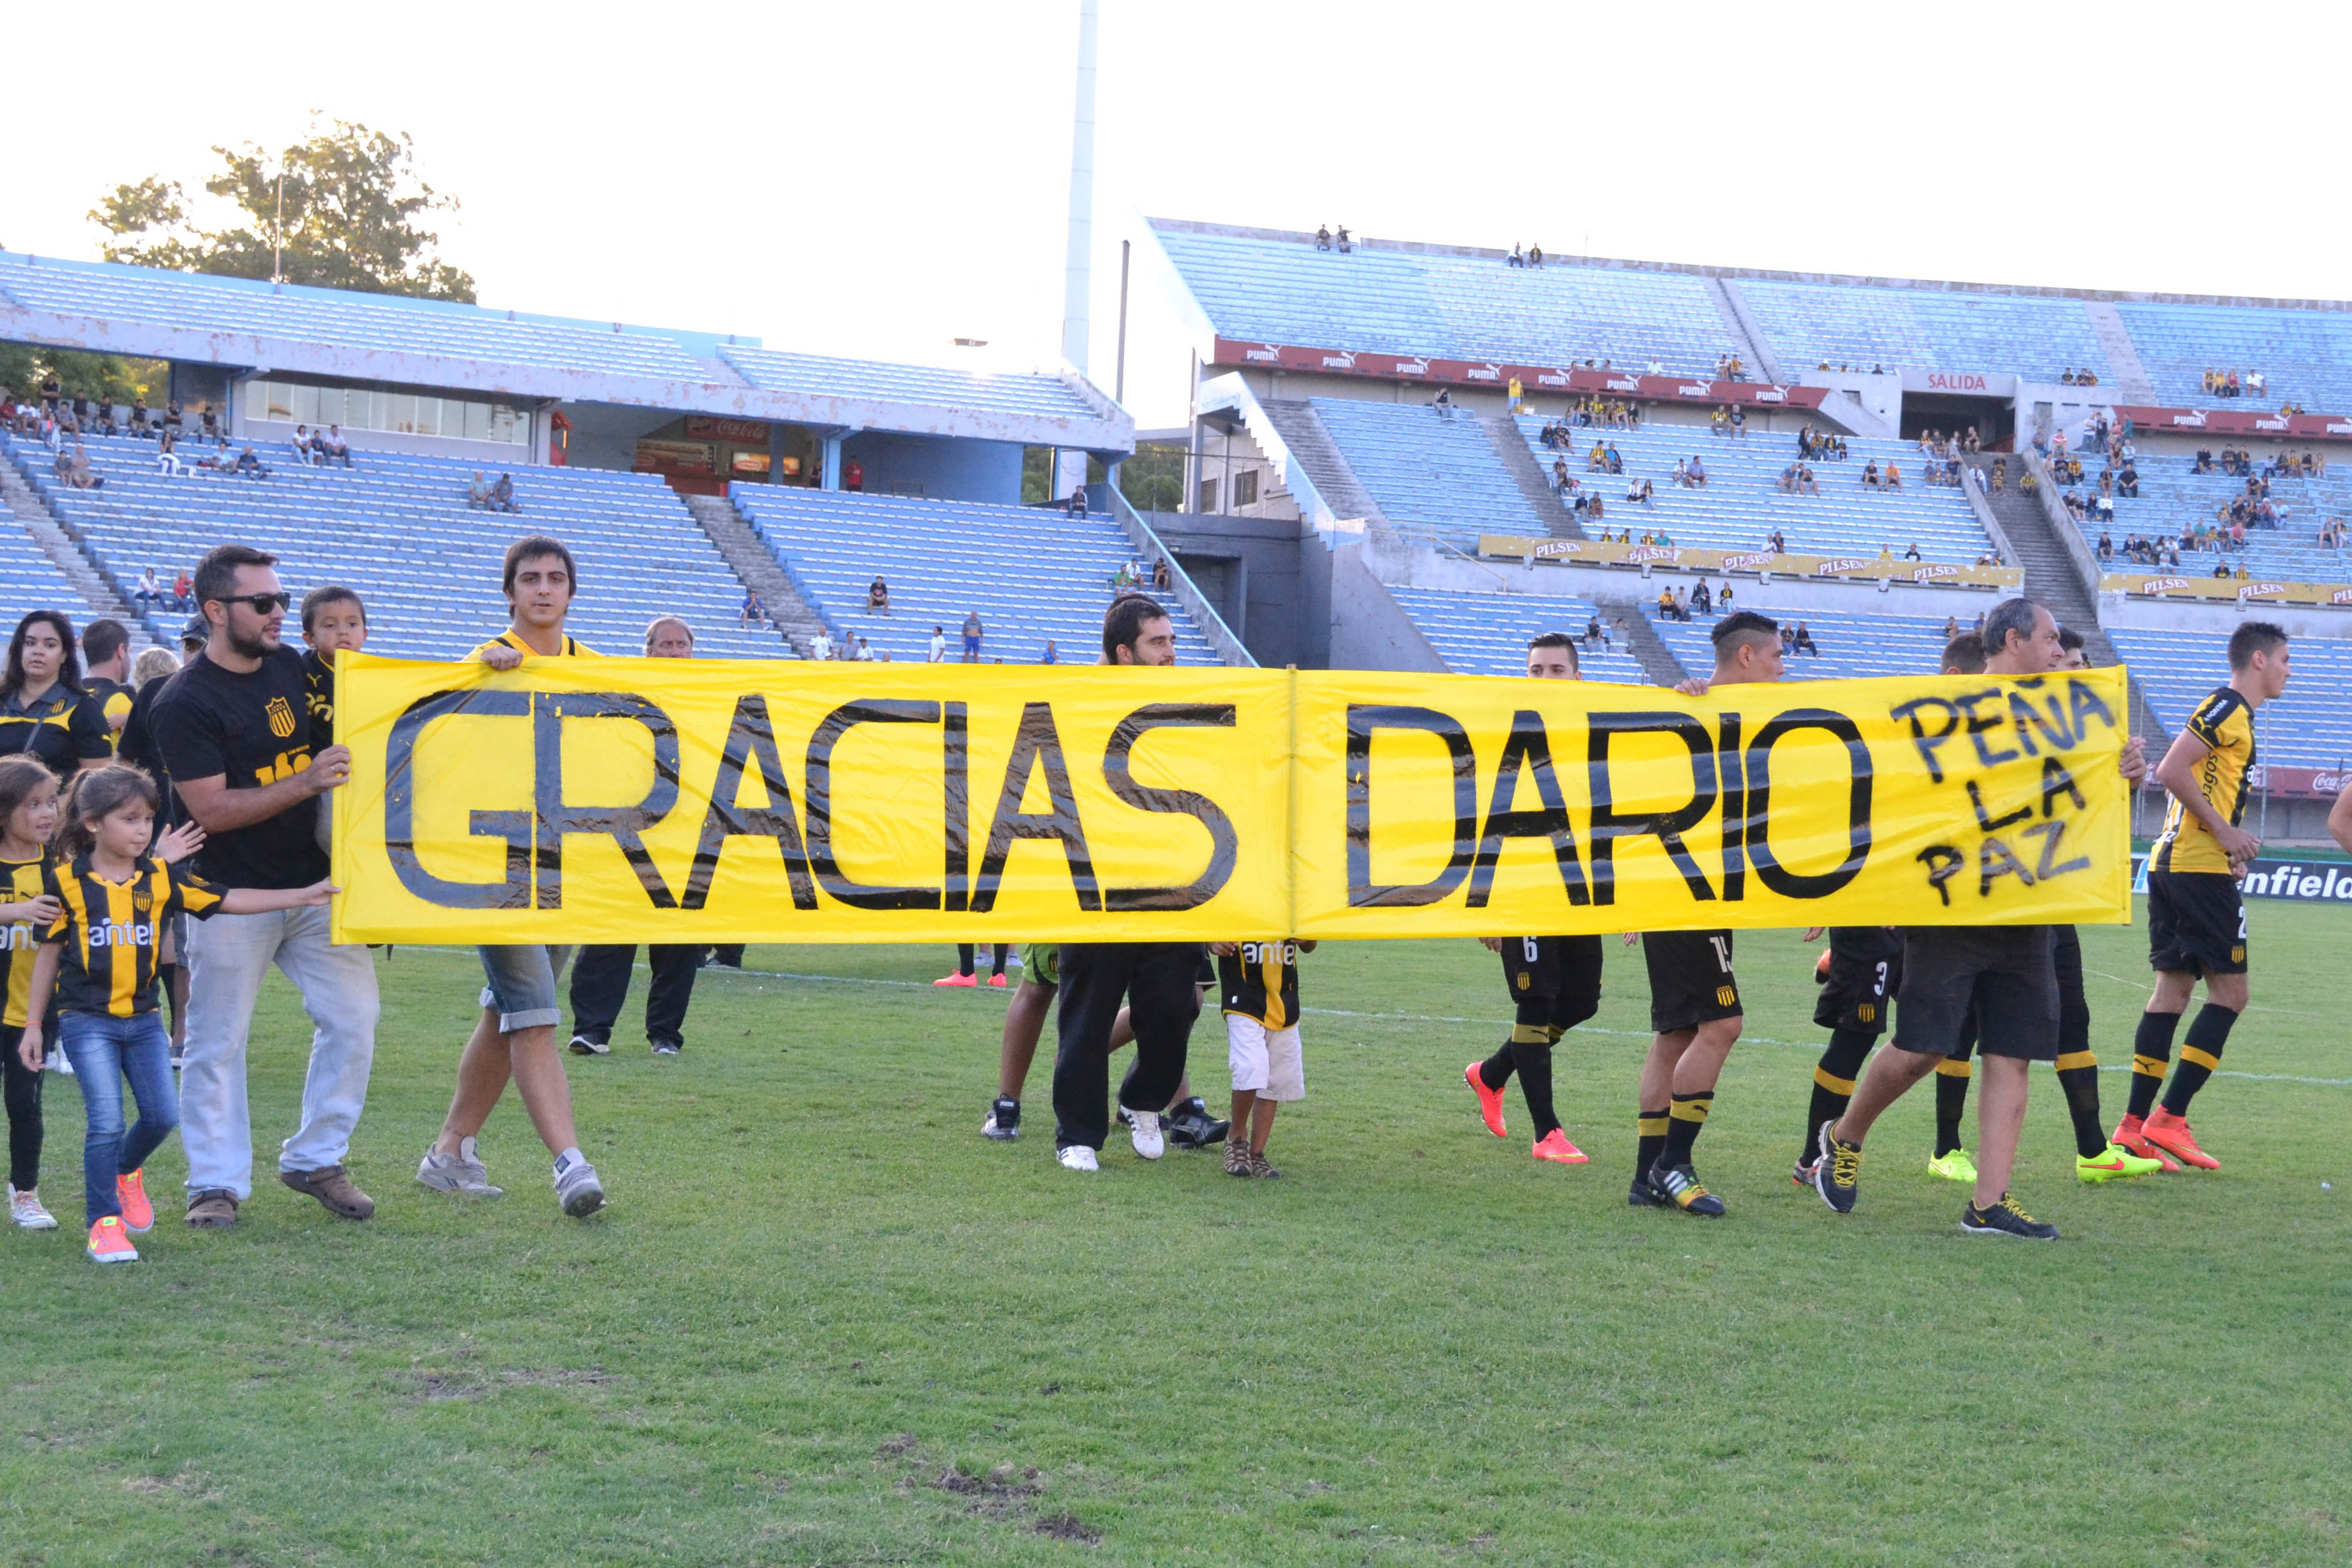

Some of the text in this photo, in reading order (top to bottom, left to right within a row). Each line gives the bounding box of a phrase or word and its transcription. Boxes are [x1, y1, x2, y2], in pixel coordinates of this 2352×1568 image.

[1247, 350, 1275, 361] PUMA
[1323, 357, 1351, 368] PUMA
[1396, 363, 1425, 375] PUMA
[1468, 368, 1496, 380] PUMA
[1538, 375, 1566, 385] PUMA
[1607, 380, 1634, 390] PUMA
[1929, 374, 1986, 390] SALIDA
[1679, 385, 1706, 396] PUMA
[1756, 391, 1784, 401] PUMA
[2173, 415, 2201, 426] PUMA
[2256, 420, 2284, 430] PUMA
[1536, 543, 1581, 557] PILSEN
[1819, 560, 1864, 575] PILSEN
[1914, 566, 1959, 580] PILSEN
[2143, 579, 2189, 594] PILSEN
[2238, 583, 2284, 599] PILSEN
[1890, 676, 2115, 783] PEÑA
[385, 689, 1873, 912] GRACIAS DARIO
[1967, 757, 2085, 832] LA
[1915, 821, 2090, 907] PAZ
[89, 917, 154, 947] antel
[1242, 940, 1295, 965] ante
[1523, 935, 1538, 962] 6
[1874, 962, 1887, 996] 3
